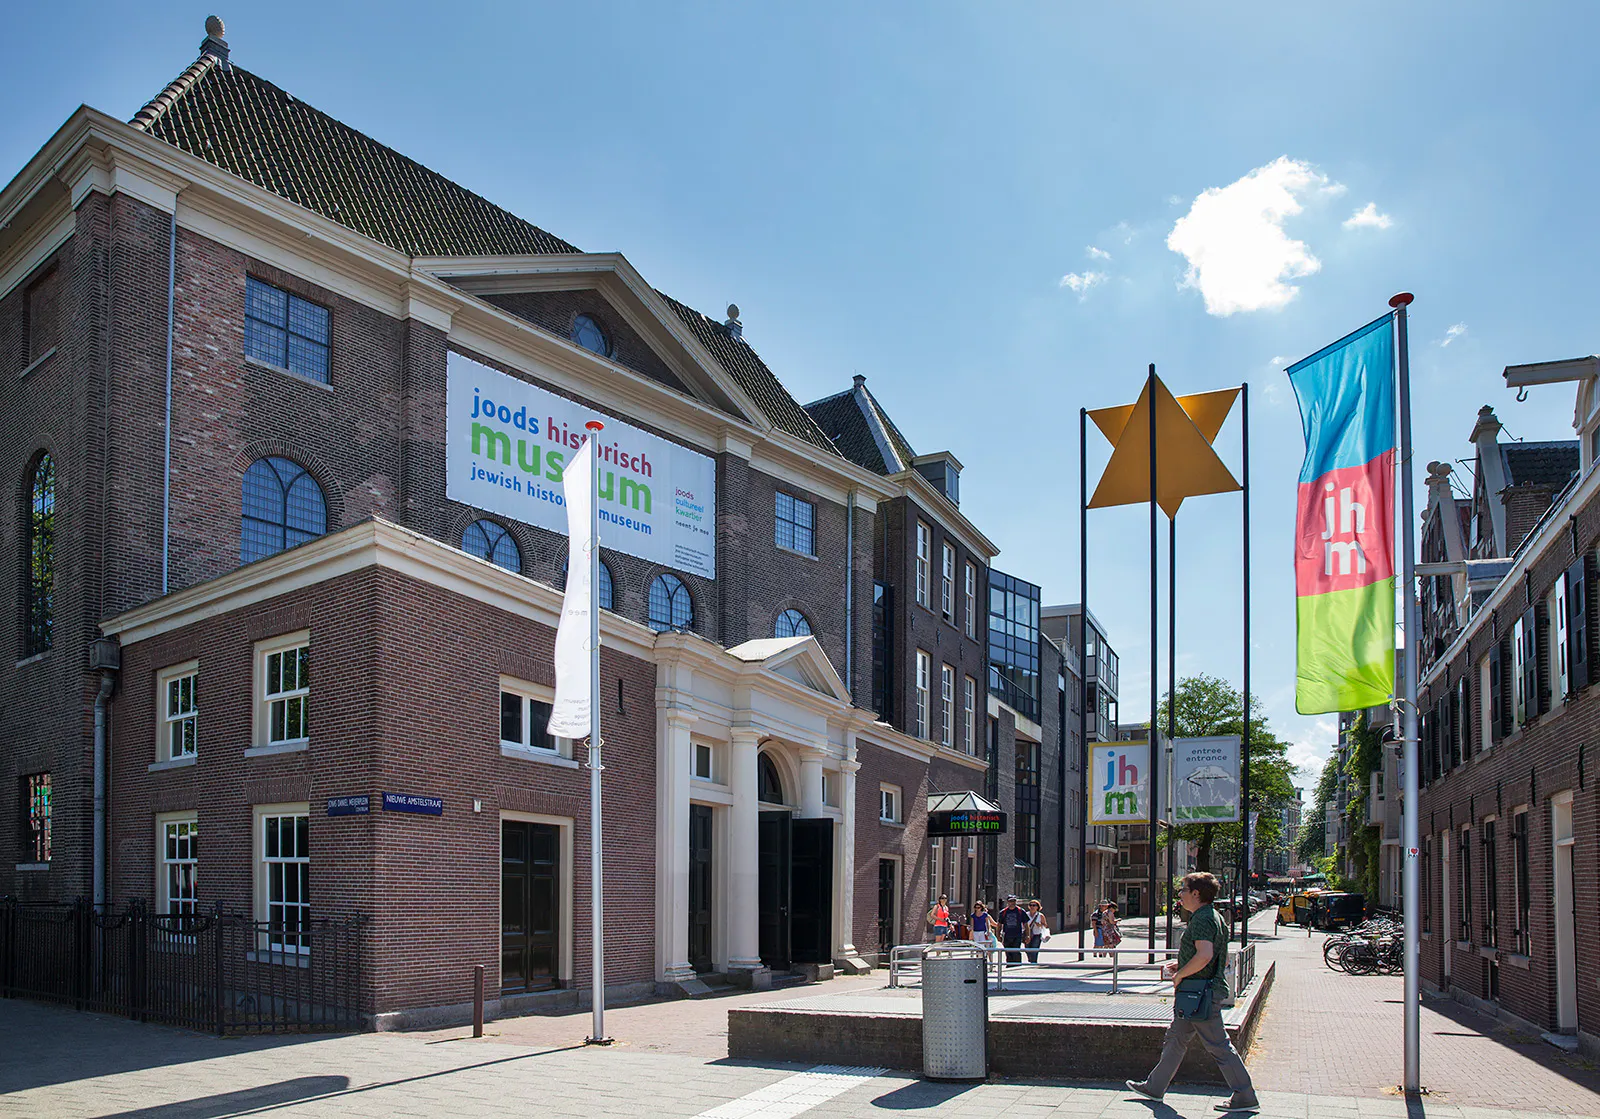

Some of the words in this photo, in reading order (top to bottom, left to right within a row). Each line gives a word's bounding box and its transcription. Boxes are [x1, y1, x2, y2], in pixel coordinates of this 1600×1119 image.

[471, 387, 539, 434] joods
[471, 422, 652, 514] musum
[471, 462, 521, 493] jewish
[599, 509, 652, 535] museum
[675, 487, 694, 500] joods
[676, 498, 704, 513] cultureel
[1321, 482, 1365, 540] jh
[1324, 540, 1366, 575] m
[1103, 751, 1138, 790] jh
[1186, 754, 1228, 762] entrance
[386, 795, 406, 804] NIEUWE
[407, 797, 442, 807] AMSTELSTRAAT
[1105, 791, 1138, 815] m
[950, 821, 1000, 829] museum
